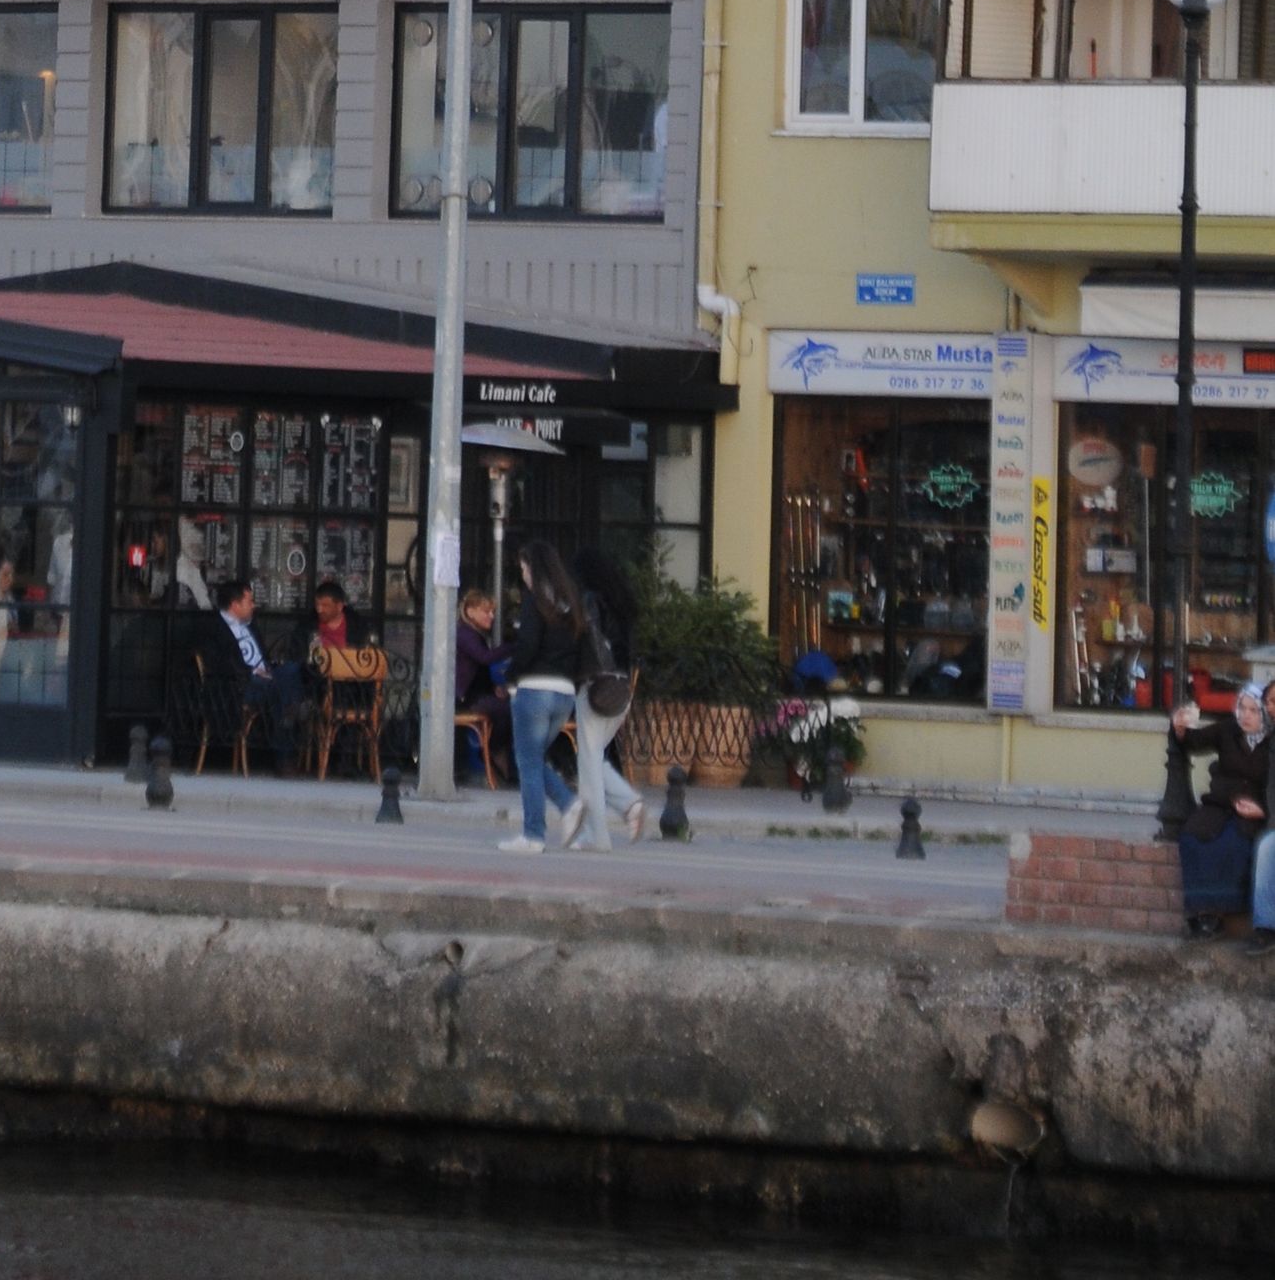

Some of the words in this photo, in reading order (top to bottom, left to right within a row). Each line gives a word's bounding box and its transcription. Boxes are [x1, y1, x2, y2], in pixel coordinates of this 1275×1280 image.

[903, 348, 933, 361] STAR
[936, 344, 993, 364] Musta
[480, 382, 526, 402] Limani
[528, 384, 557, 403] Cafe
[889, 377, 919, 390] 0286
[924, 377, 944, 390] 217
[951, 378, 965, 390] 27
[970, 378, 985, 390] 36
[1194, 385, 1223, 399] 0286
[1229, 386, 1249, 399] 217
[1255, 387, 1269, 400] 27
[535, 418, 564, 441] PORT
[1032, 515, 1049, 625] Cressi-sub
